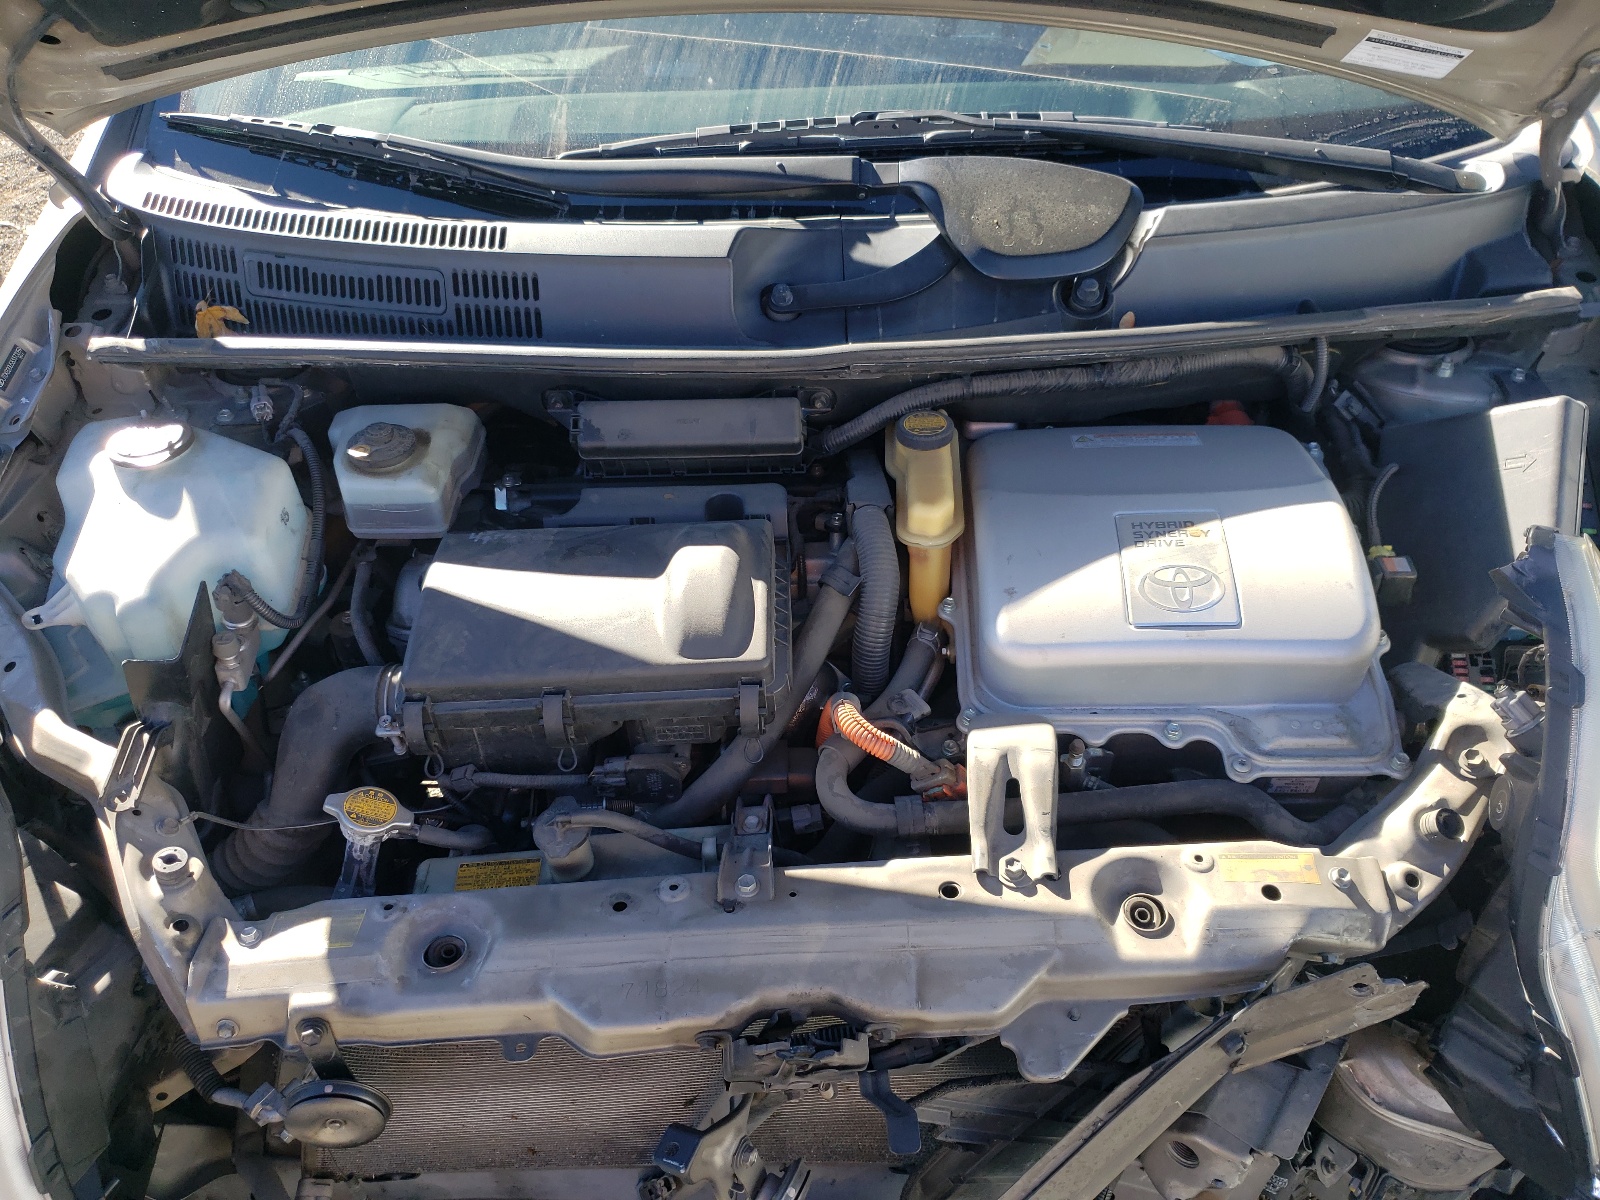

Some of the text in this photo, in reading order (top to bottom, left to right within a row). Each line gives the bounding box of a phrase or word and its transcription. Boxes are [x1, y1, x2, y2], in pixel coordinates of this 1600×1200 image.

[1131, 520, 1194, 529] HYBRID
[1132, 529, 1210, 538] SYNERGY
[1134, 539, 1185, 547] DRIVE
